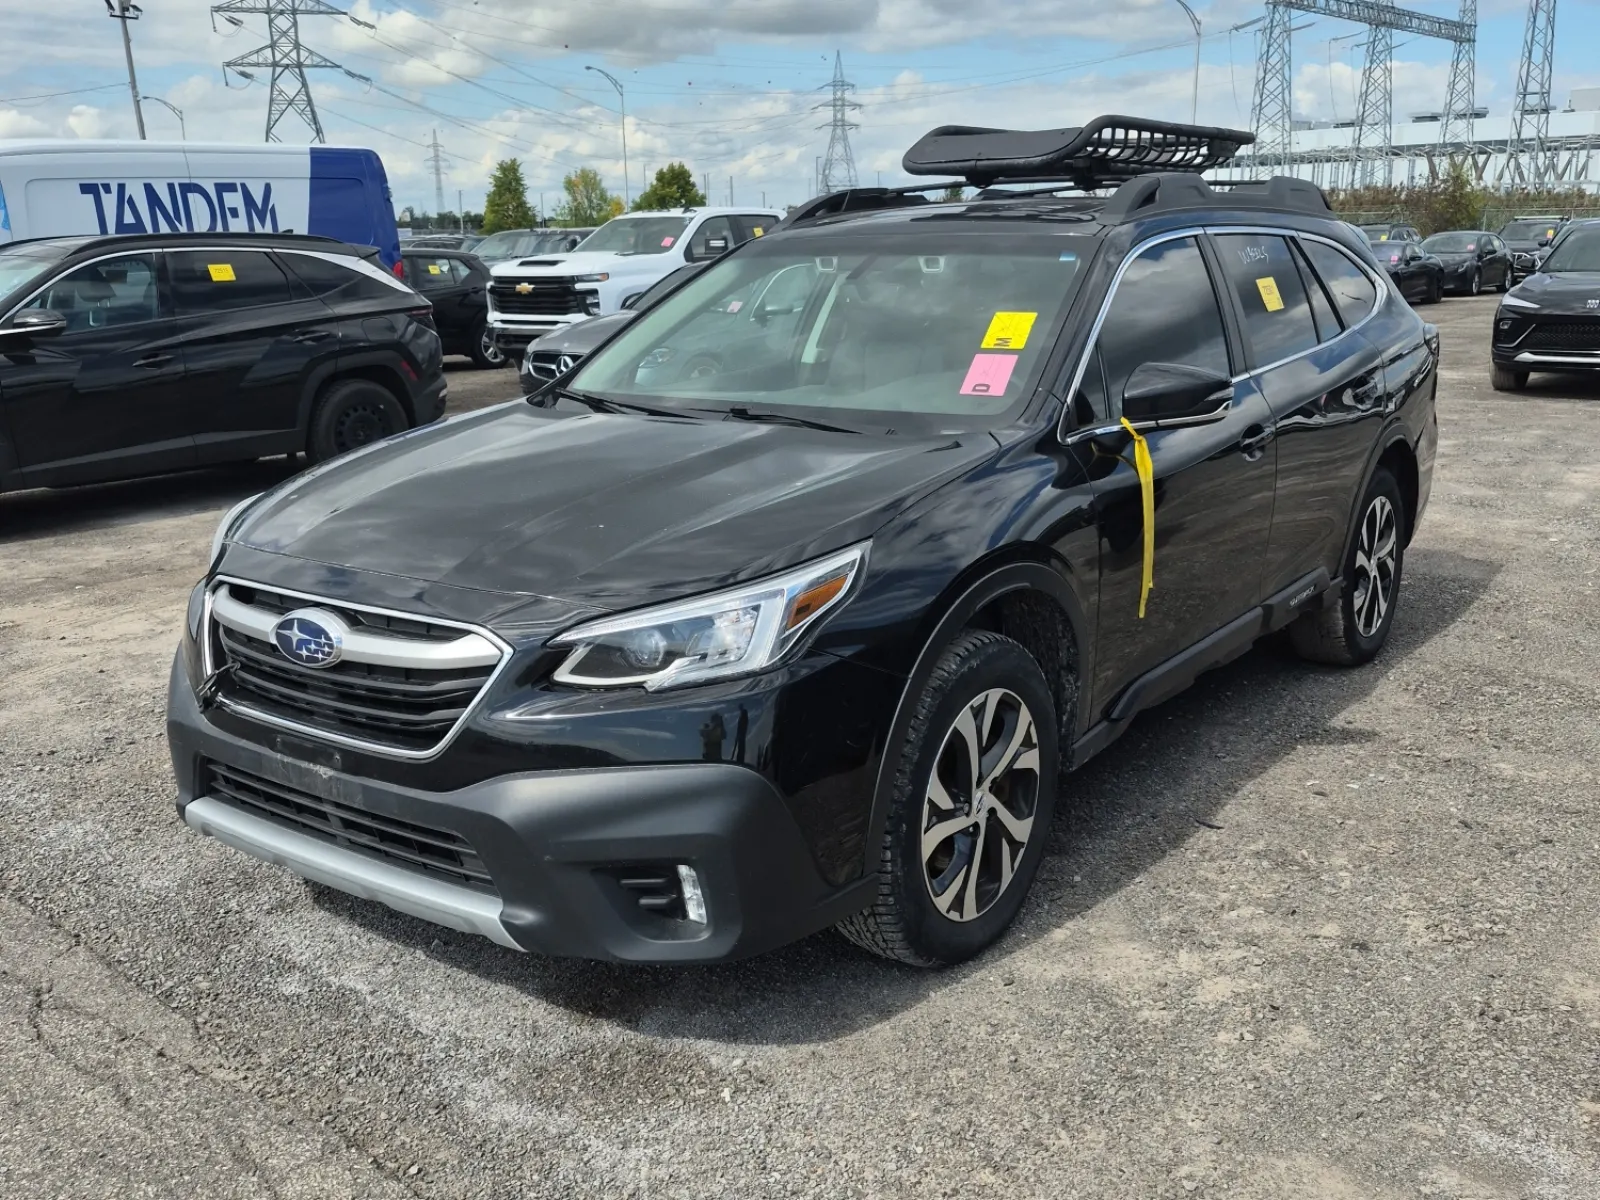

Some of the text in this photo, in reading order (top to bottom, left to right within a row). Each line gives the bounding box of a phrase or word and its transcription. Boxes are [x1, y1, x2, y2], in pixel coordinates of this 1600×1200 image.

[79, 182, 279, 235] TANDEM
[993, 337, 1013, 347] M
[972, 383, 991, 392] D
